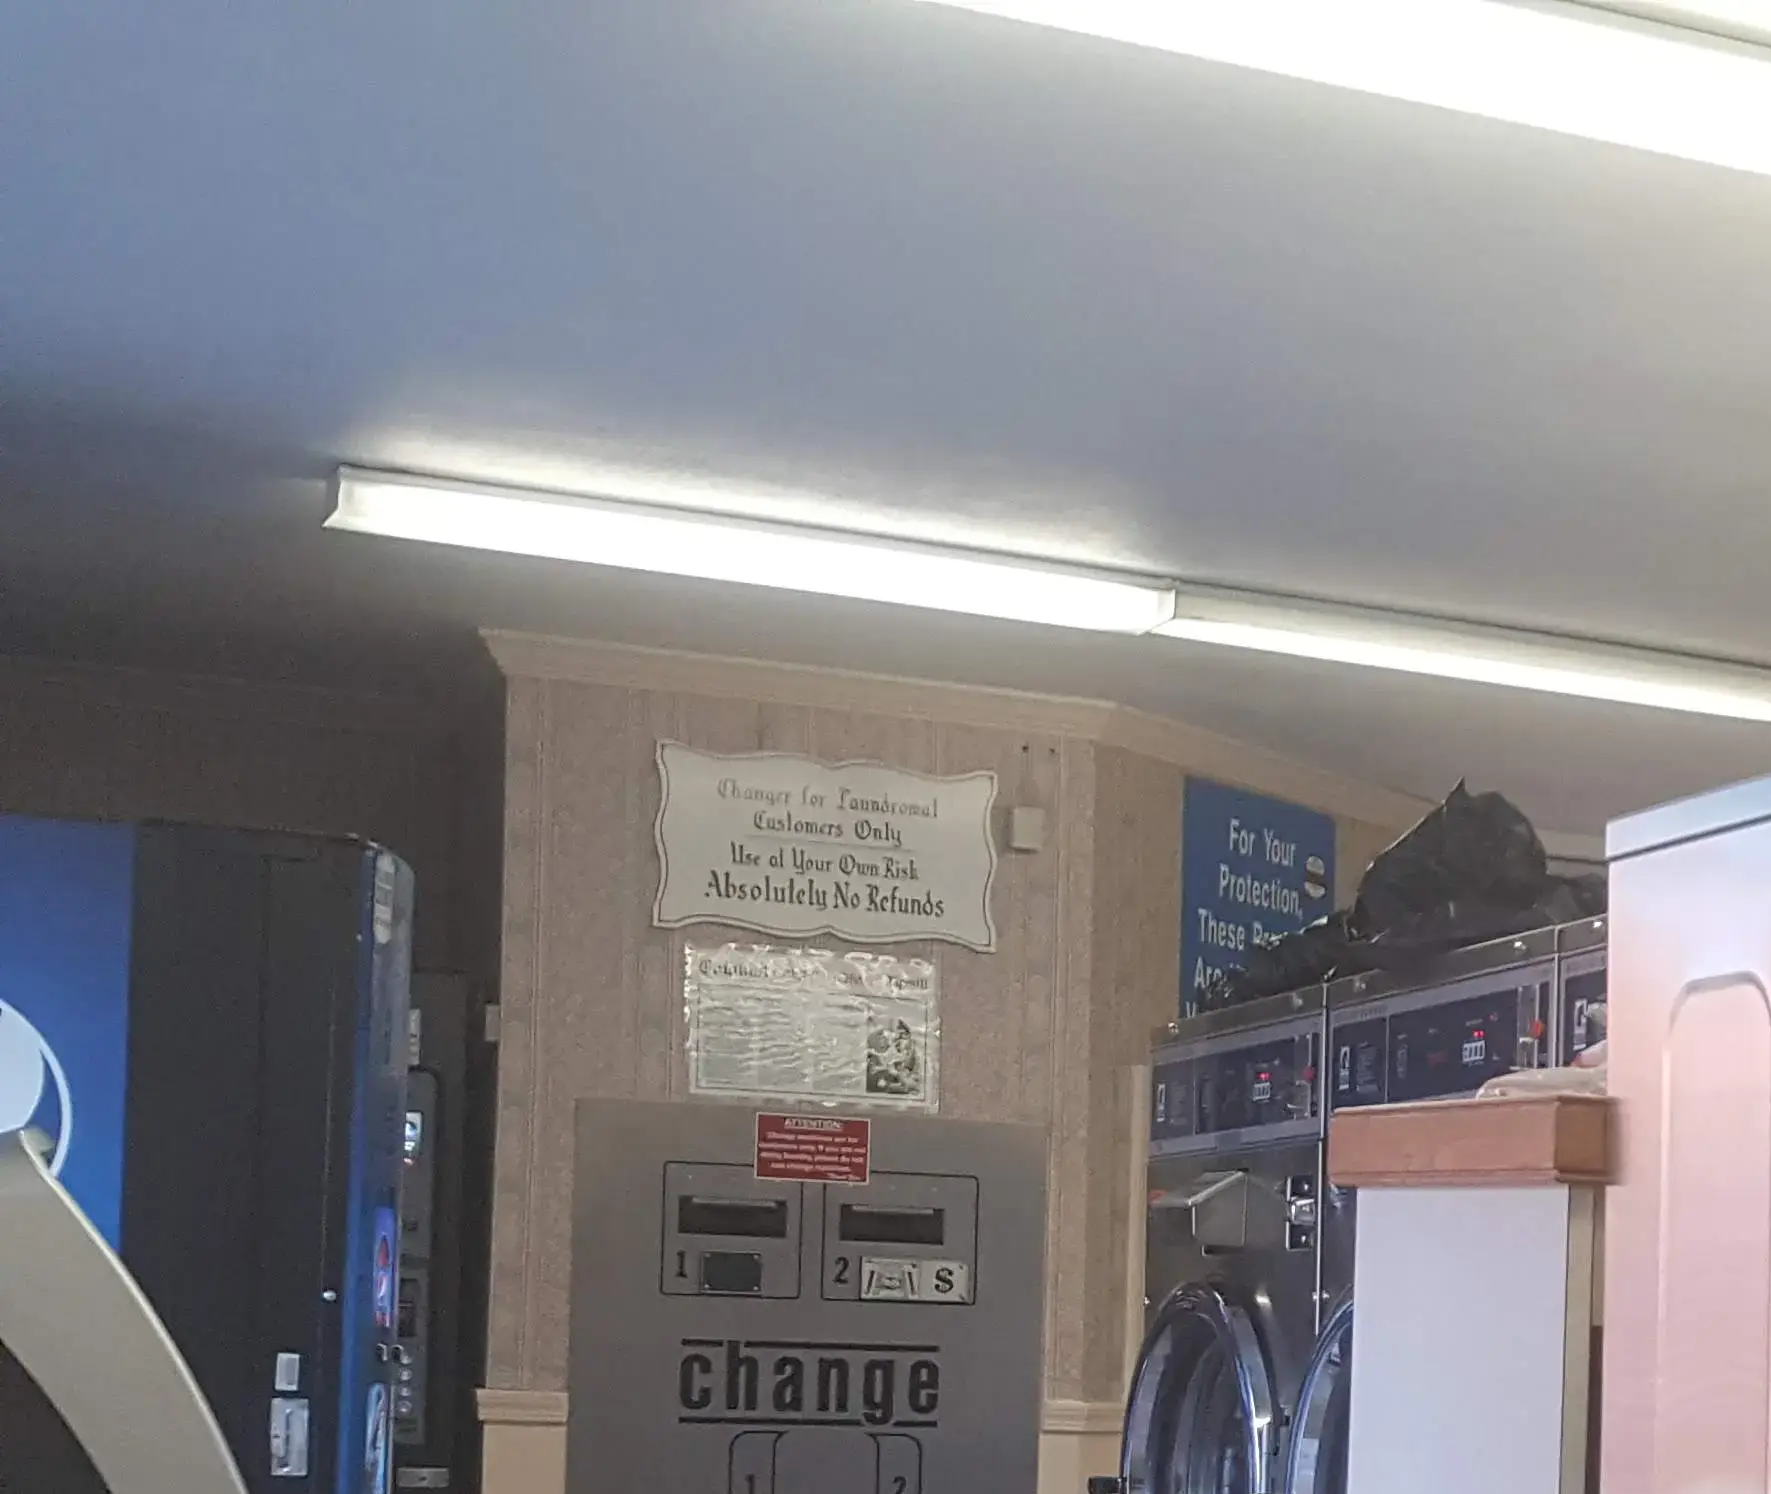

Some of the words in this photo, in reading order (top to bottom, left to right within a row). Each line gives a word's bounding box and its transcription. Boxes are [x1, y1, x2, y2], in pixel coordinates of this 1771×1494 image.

[802, 783, 827, 808] for
[753, 811, 844, 838] Customers
[854, 819, 902, 848] Only
[1229, 818, 1255, 856] For
[1264, 828, 1297, 868] Your
[730, 841, 760, 866] Use
[769, 848, 784, 869] at
[792, 846, 833, 875] Your
[838, 854, 880, 877] Own
[882, 857, 920, 881] Risk
[704, 869, 829, 911] Absolutely
[833, 880, 861, 910] No
[865, 883, 945, 918] Refunds
[1198, 907, 1245, 951] These
[675, 1250, 688, 1278] 1
[832, 1256, 850, 1284] 2
[679, 1340, 940, 1426] change
